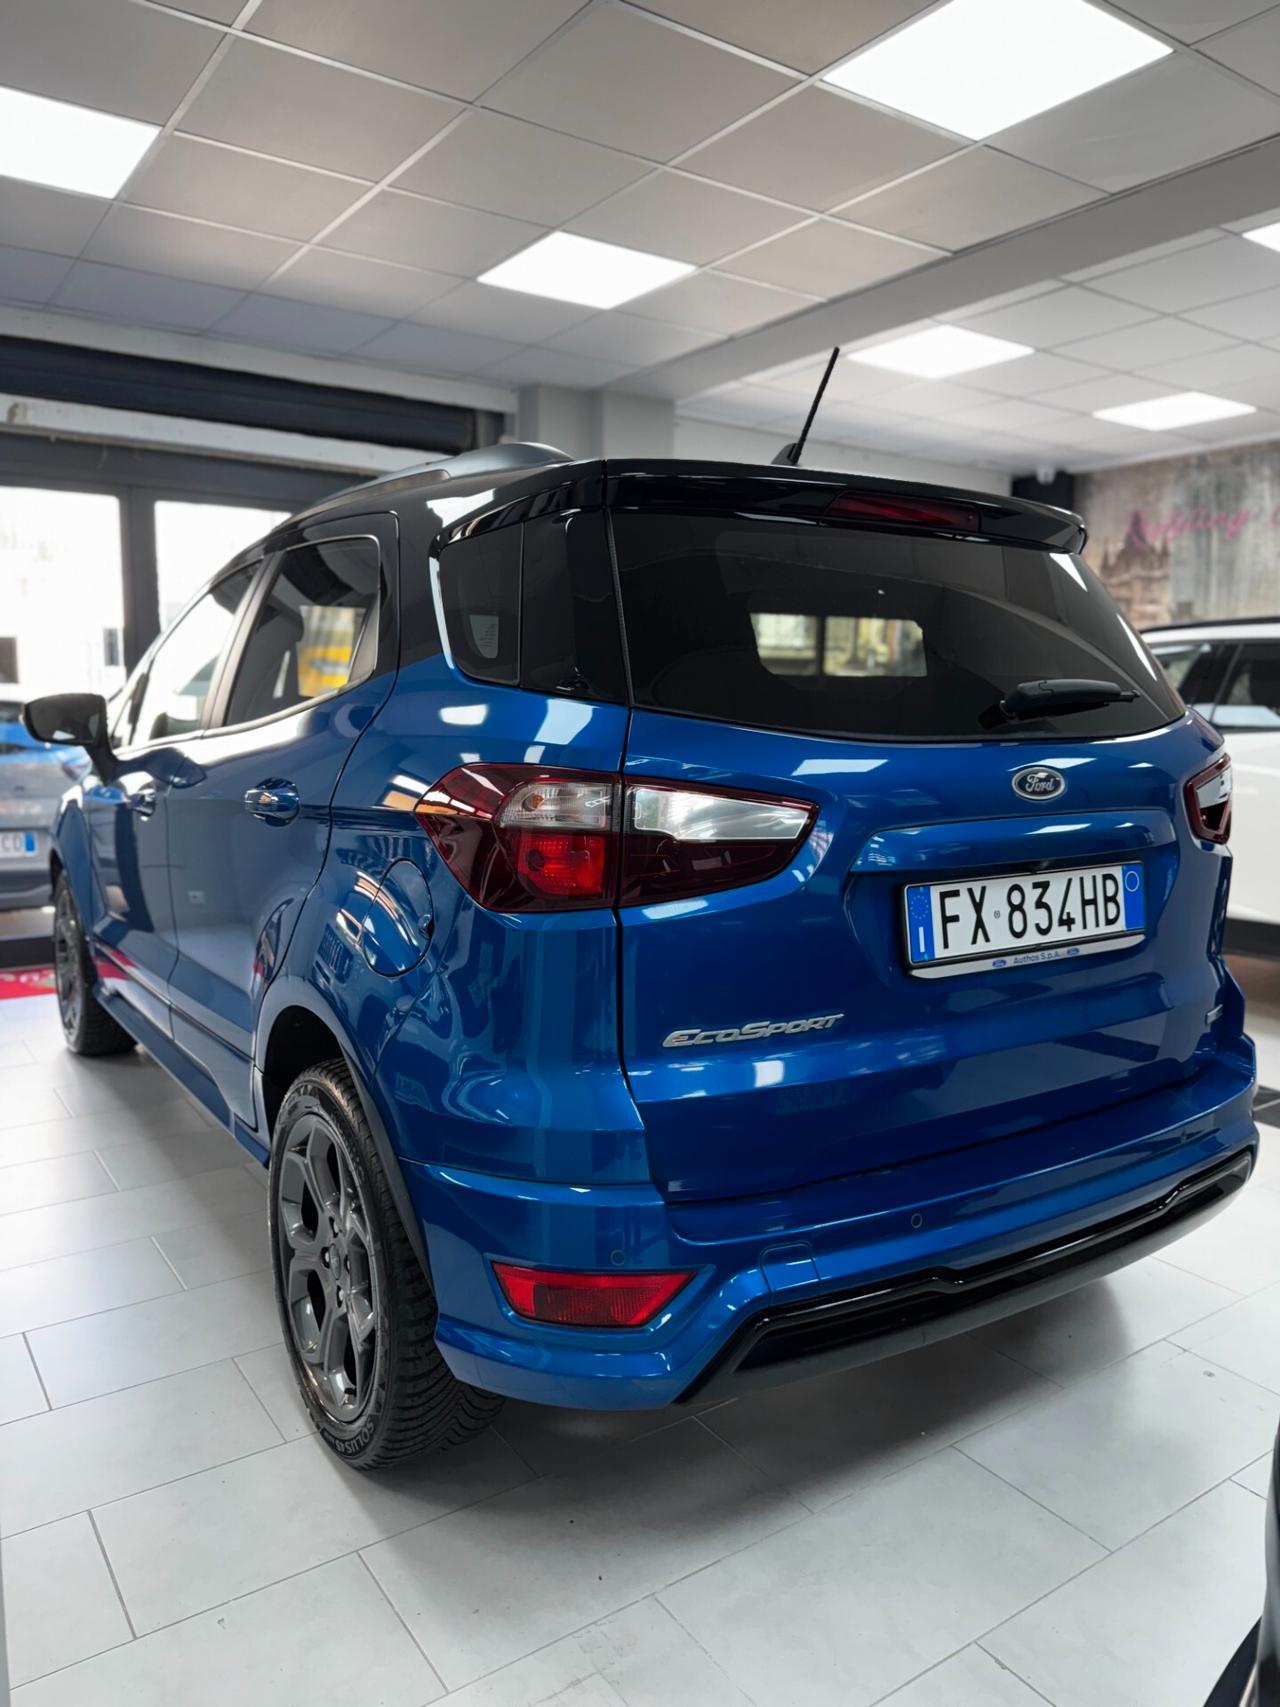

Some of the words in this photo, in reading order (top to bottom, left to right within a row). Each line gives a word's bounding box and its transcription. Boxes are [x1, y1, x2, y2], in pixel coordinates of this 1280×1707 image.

[1025, 772, 1055, 792] Ford
[939, 885, 990, 949] FX
[1006, 873, 1121, 939] 834HB
